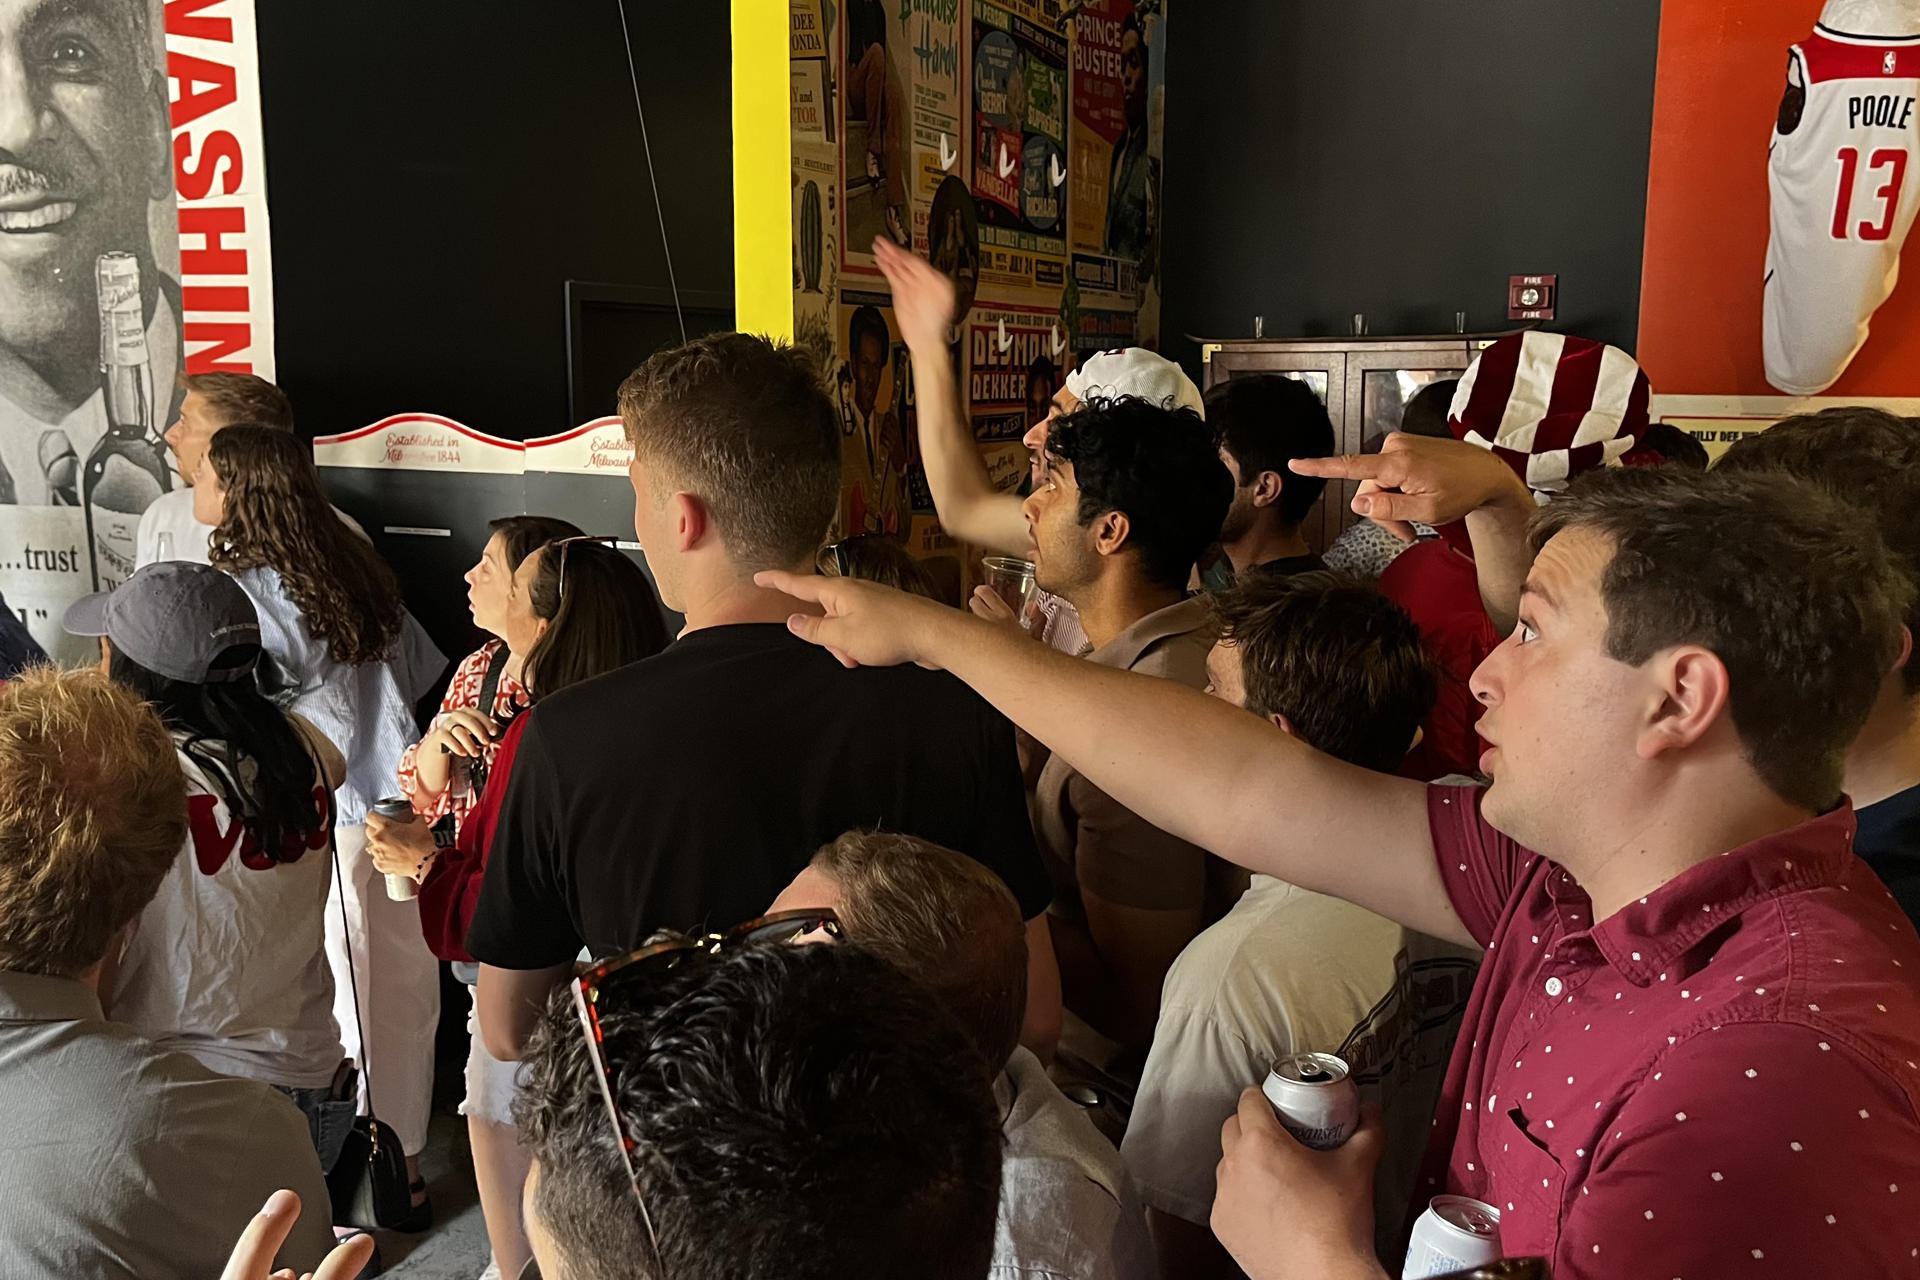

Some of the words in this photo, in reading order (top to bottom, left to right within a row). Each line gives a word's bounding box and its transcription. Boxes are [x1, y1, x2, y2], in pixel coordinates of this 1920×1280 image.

[793, 13, 815, 30] DEE
[1076, 13, 1121, 48] PRINCE
[1075, 43, 1122, 79] BUSTER
[1849, 95, 1916, 130] POOLE
[1830, 146, 1908, 241] 13
[972, 373, 1027, 401] DEKKER
[385, 432, 445, 449] Established
[447, 437, 460, 448] in
[437, 450, 461, 464] 1844
